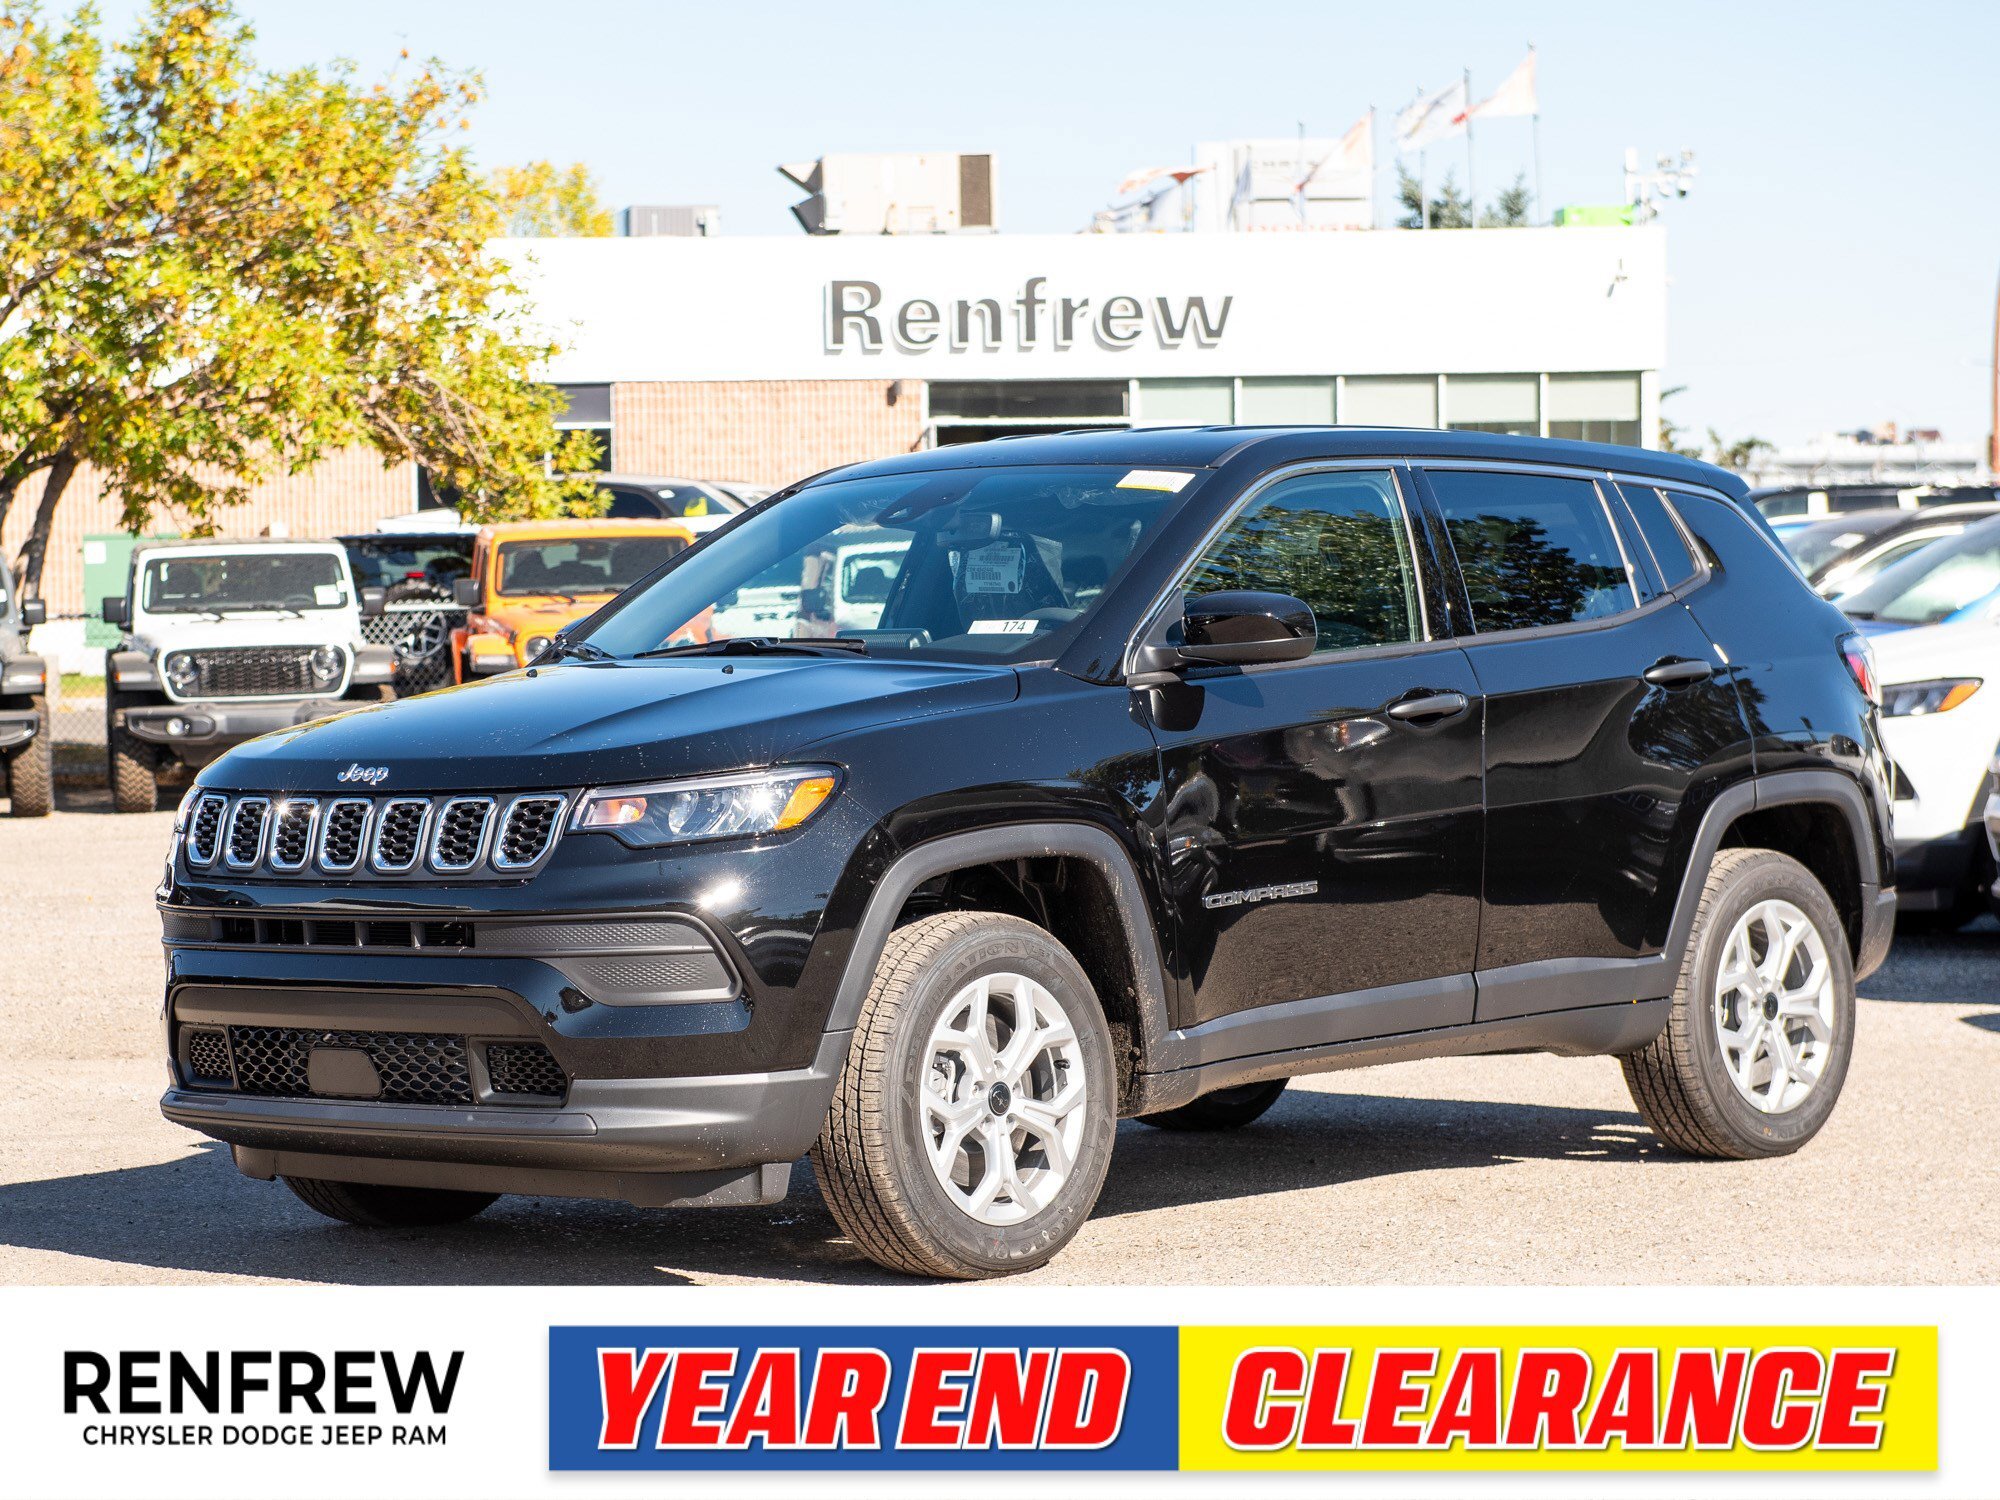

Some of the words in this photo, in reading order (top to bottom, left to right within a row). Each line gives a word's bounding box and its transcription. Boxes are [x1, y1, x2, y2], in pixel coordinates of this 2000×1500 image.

[824, 276, 1233, 355] Renfrew
[1003, 621, 1026, 632] 174
[337, 763, 389, 786] Jeep
[1203, 880, 1319, 909] COMPASS
